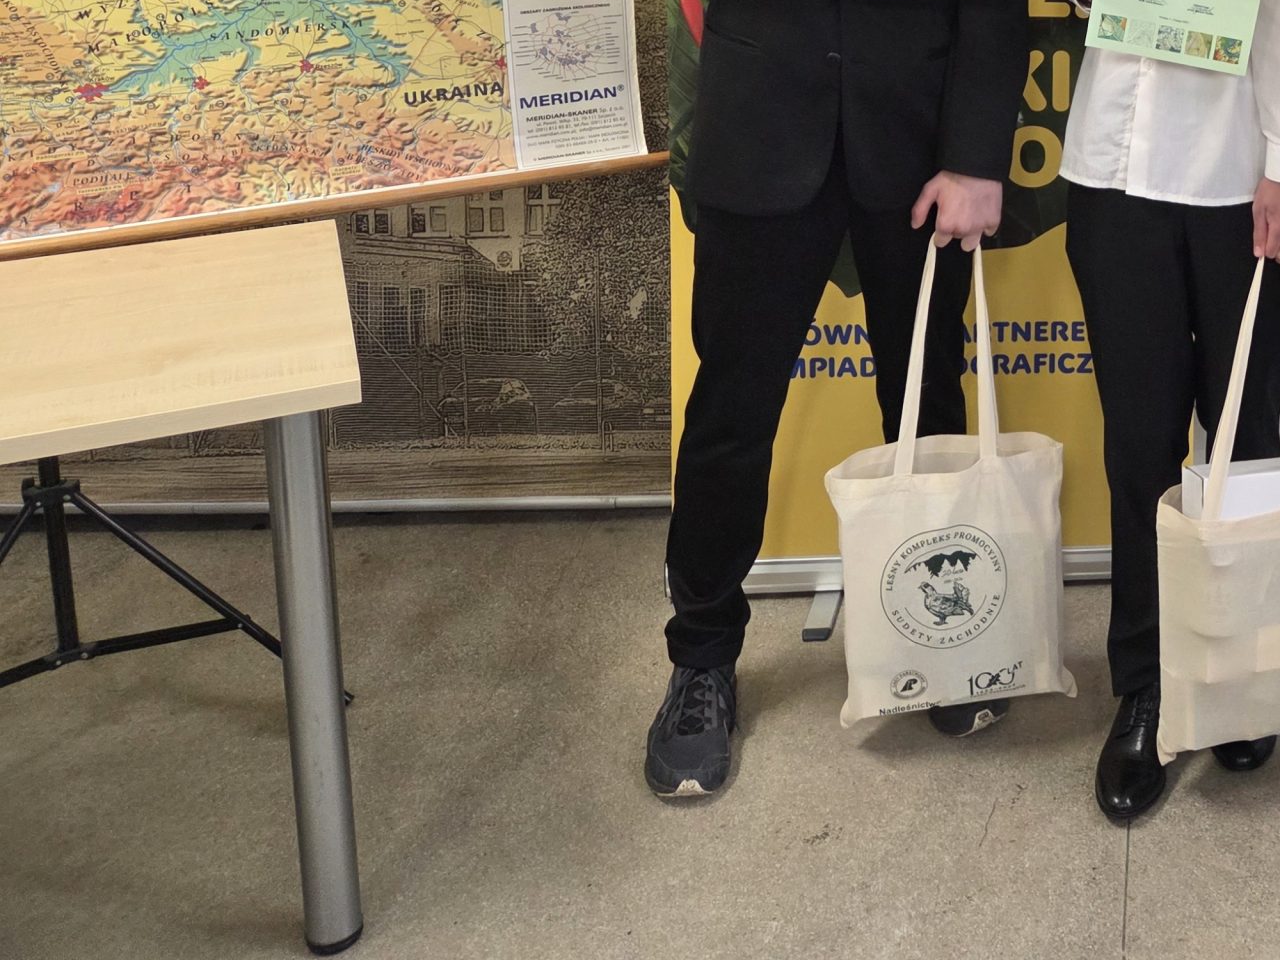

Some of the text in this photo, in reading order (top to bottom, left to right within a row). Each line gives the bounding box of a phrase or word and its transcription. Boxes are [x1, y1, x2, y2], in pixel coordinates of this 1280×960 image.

[404, 80, 505, 107] UKRAINA
[901, 533, 951, 560] KOMPLEKS
[953, 531, 1001, 573] PROMOCYJNY
[892, 594, 1001, 644] SUDETY ZACHODNIE
